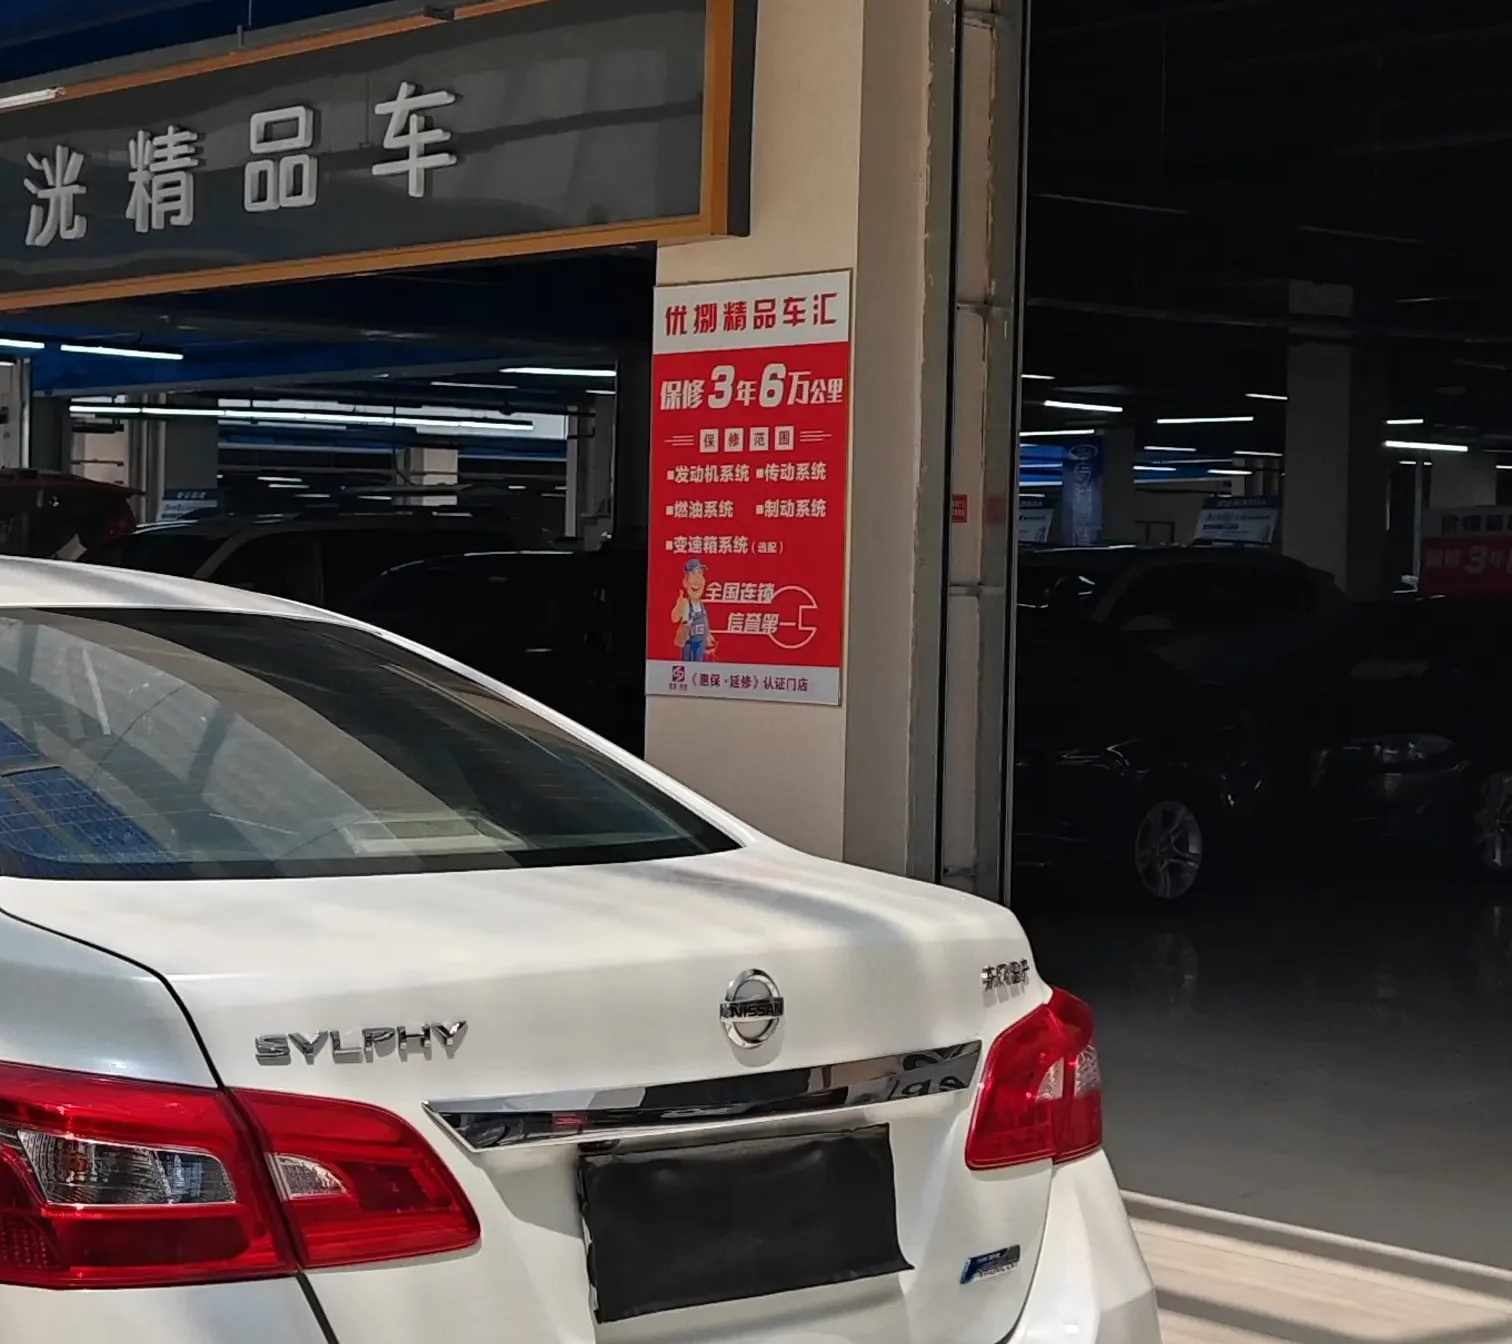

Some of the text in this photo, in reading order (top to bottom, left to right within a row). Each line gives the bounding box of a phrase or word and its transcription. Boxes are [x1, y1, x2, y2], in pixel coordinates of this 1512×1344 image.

[664, 292, 838, 337] 优捌精品车汇
[660, 362, 844, 411] 保修3年6万公里
[702, 428, 791, 450] 保修范围
[674, 461, 827, 484] 发动机系统 传动系统
[673, 498, 827, 519] 燃油系统 制动系统
[705, 581, 775, 603] 全国连锁
[727, 612, 796, 635] 信誉第一
[730, 997, 783, 1018] NISSAN
[254, 1020, 468, 1065] SYLPHY
